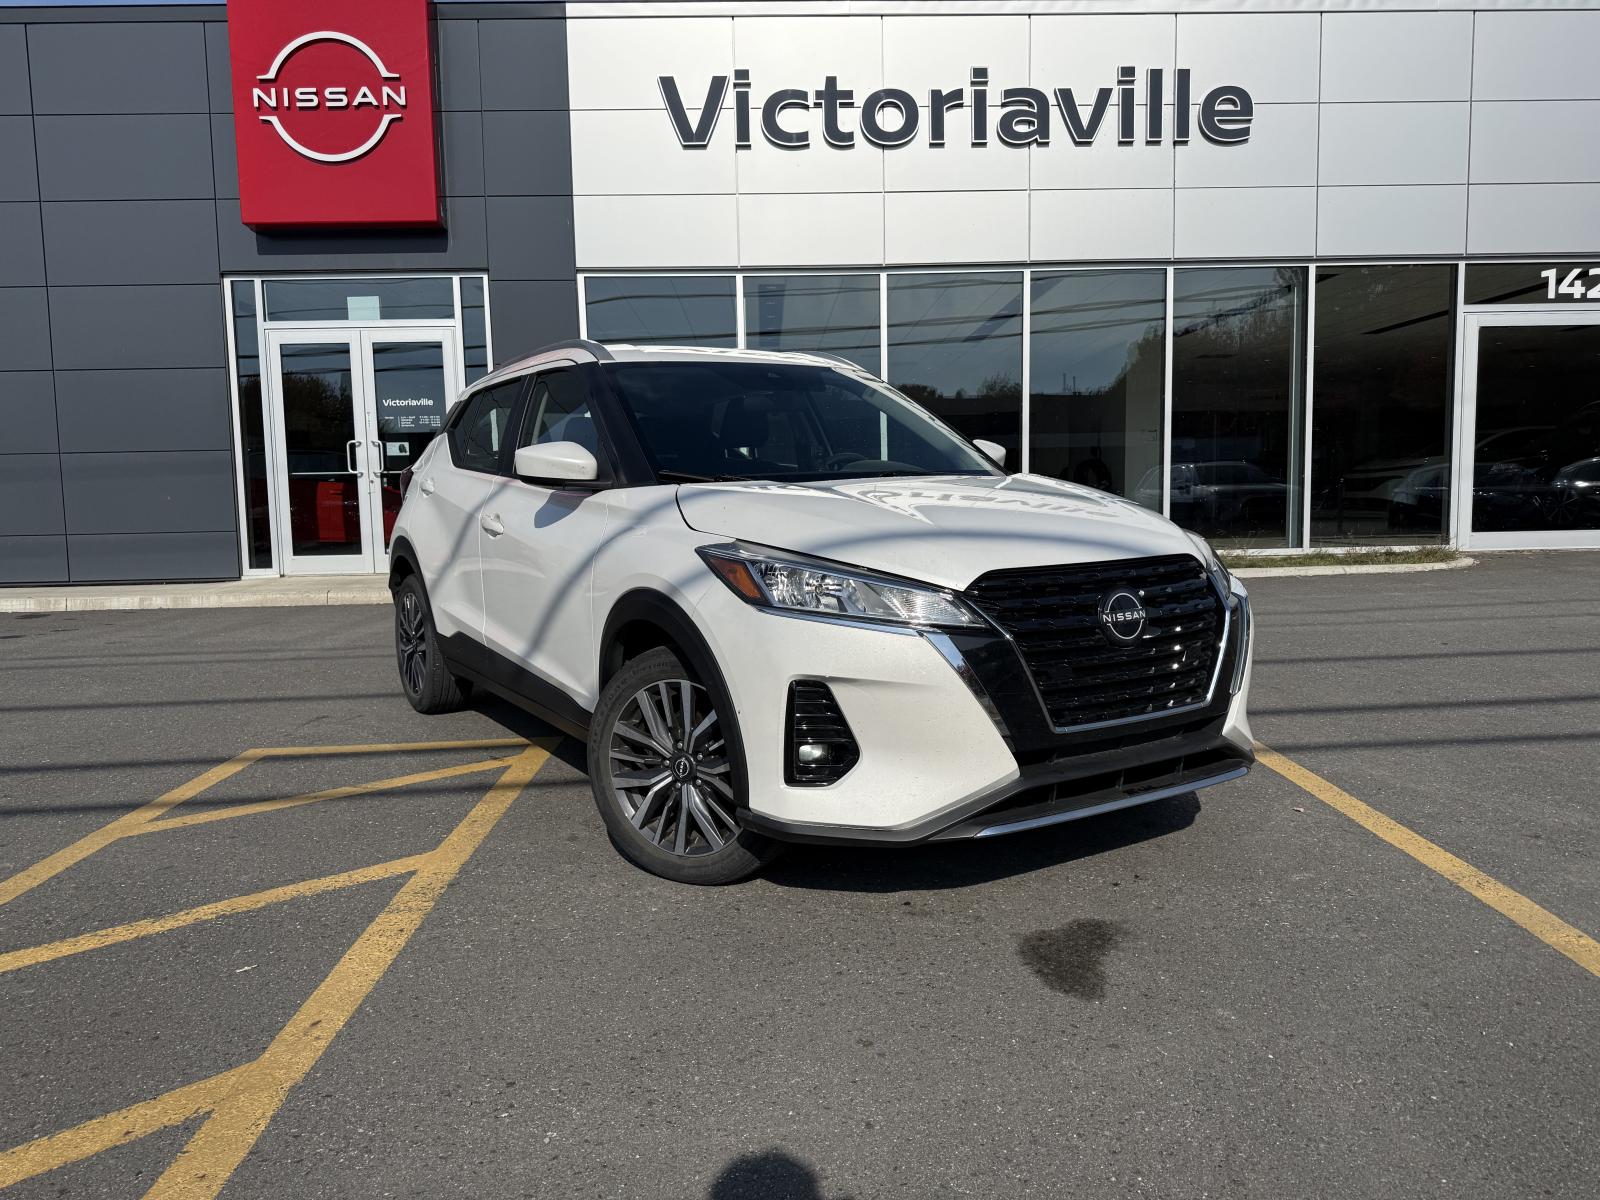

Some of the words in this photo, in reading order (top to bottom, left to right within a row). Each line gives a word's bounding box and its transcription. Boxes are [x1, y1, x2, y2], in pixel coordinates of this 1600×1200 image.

[252, 86, 406, 108] NISSAN
[657, 66, 1254, 149] Victoriaville
[382, 398, 433, 406] Victoriaville
[1102, 609, 1146, 622] NISSAN
